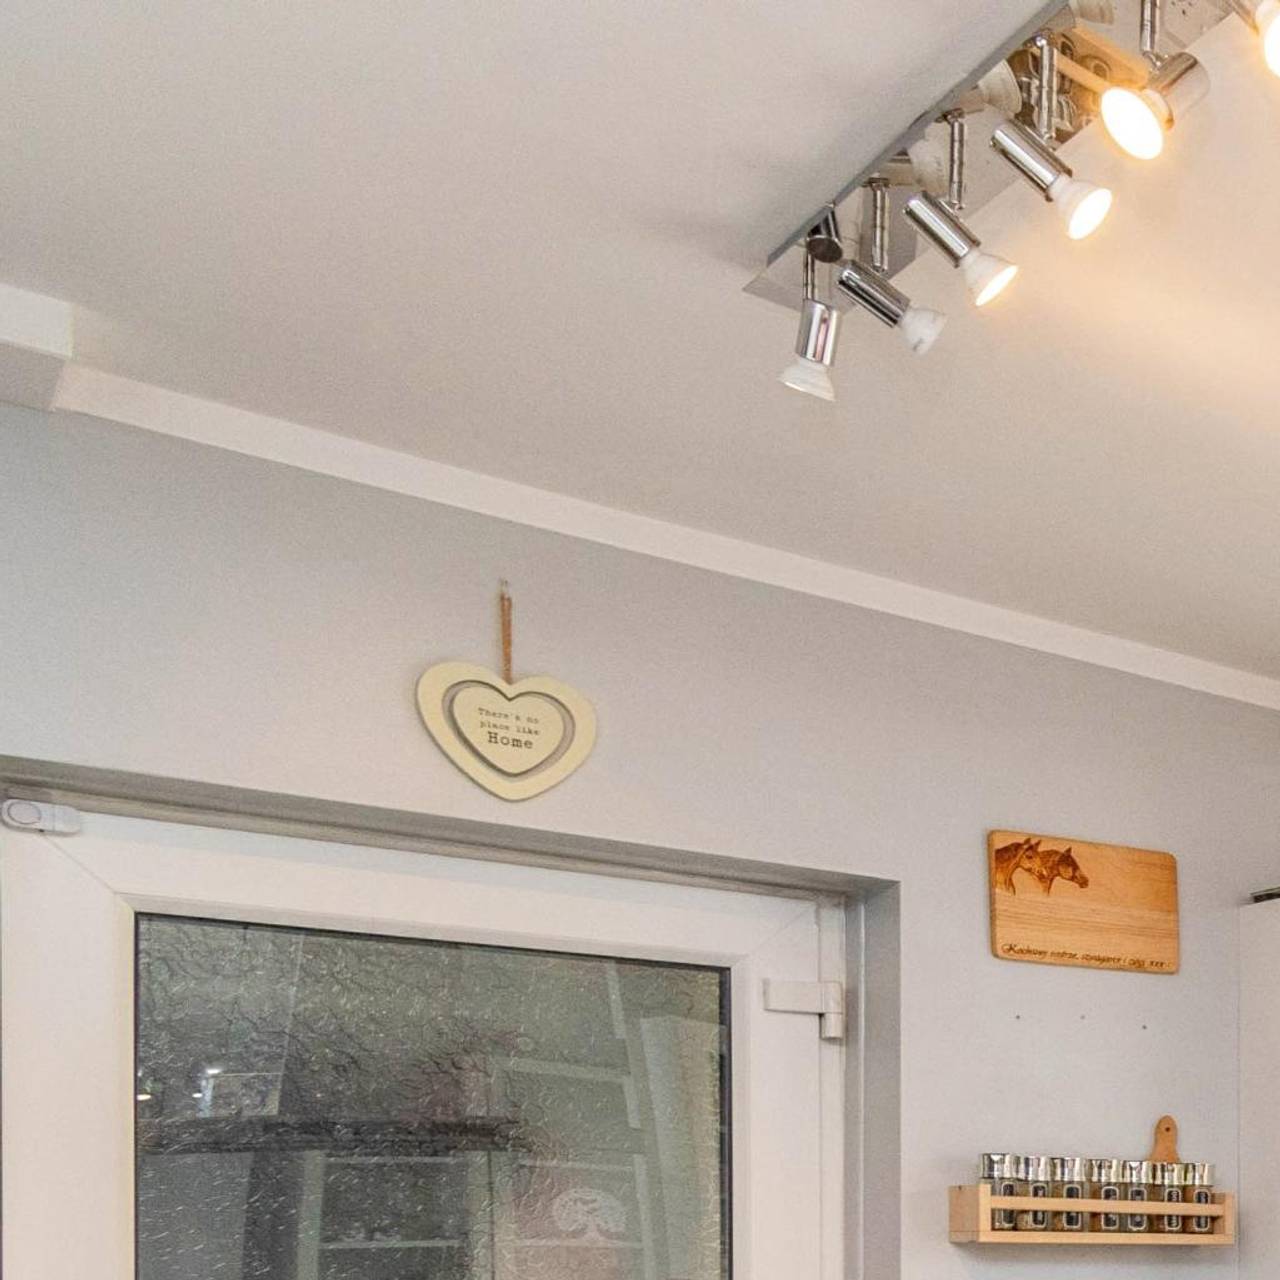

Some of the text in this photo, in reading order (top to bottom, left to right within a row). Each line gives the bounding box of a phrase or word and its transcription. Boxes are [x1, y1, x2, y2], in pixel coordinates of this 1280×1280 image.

[477, 706, 539, 725] There's no
[479, 720, 540, 736] place like
[487, 730, 534, 749] Home
